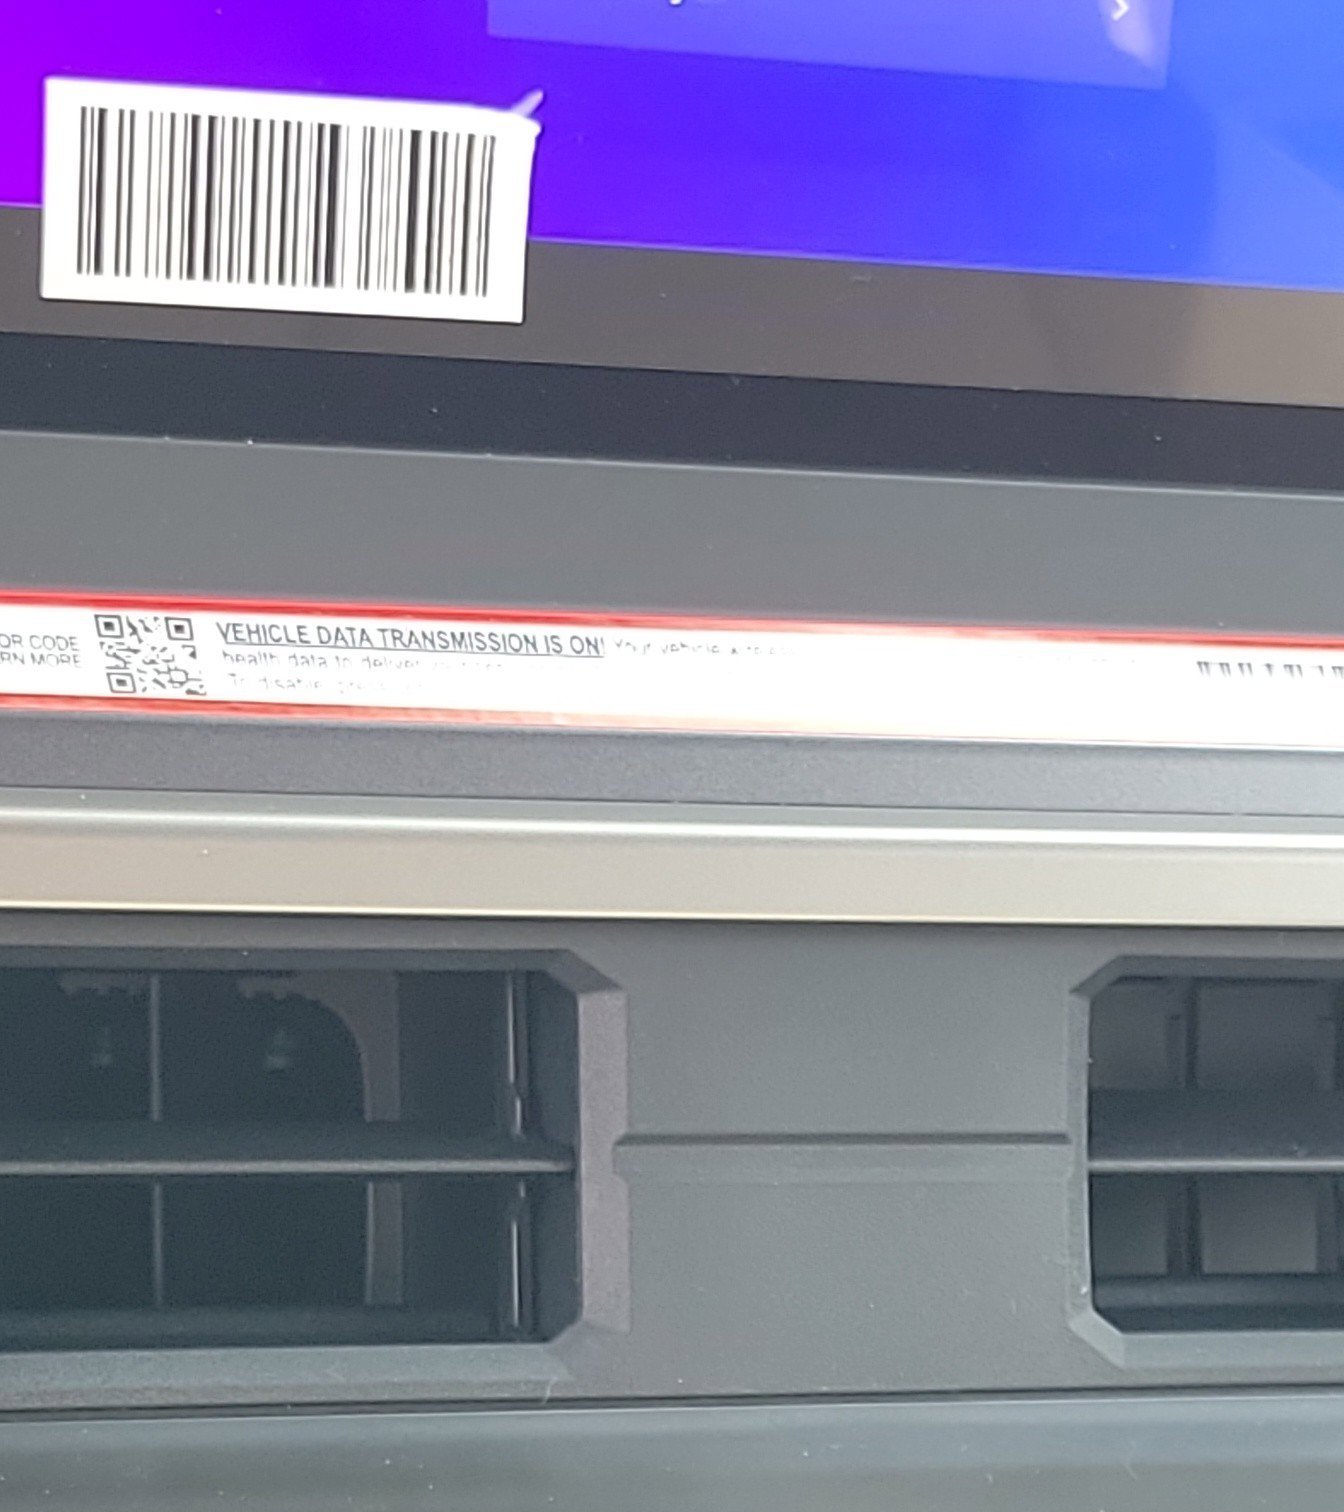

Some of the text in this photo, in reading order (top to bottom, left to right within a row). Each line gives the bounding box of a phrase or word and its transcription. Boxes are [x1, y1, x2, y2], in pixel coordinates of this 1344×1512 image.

[29, 635, 80, 652] CODE
[216, 622, 311, 645] VEHICLE
[316, 625, 375, 648] DATA
[377, 628, 539, 653] TRANSMISSION
[544, 634, 563, 654] IS
[30, 652, 82, 668] MORE
